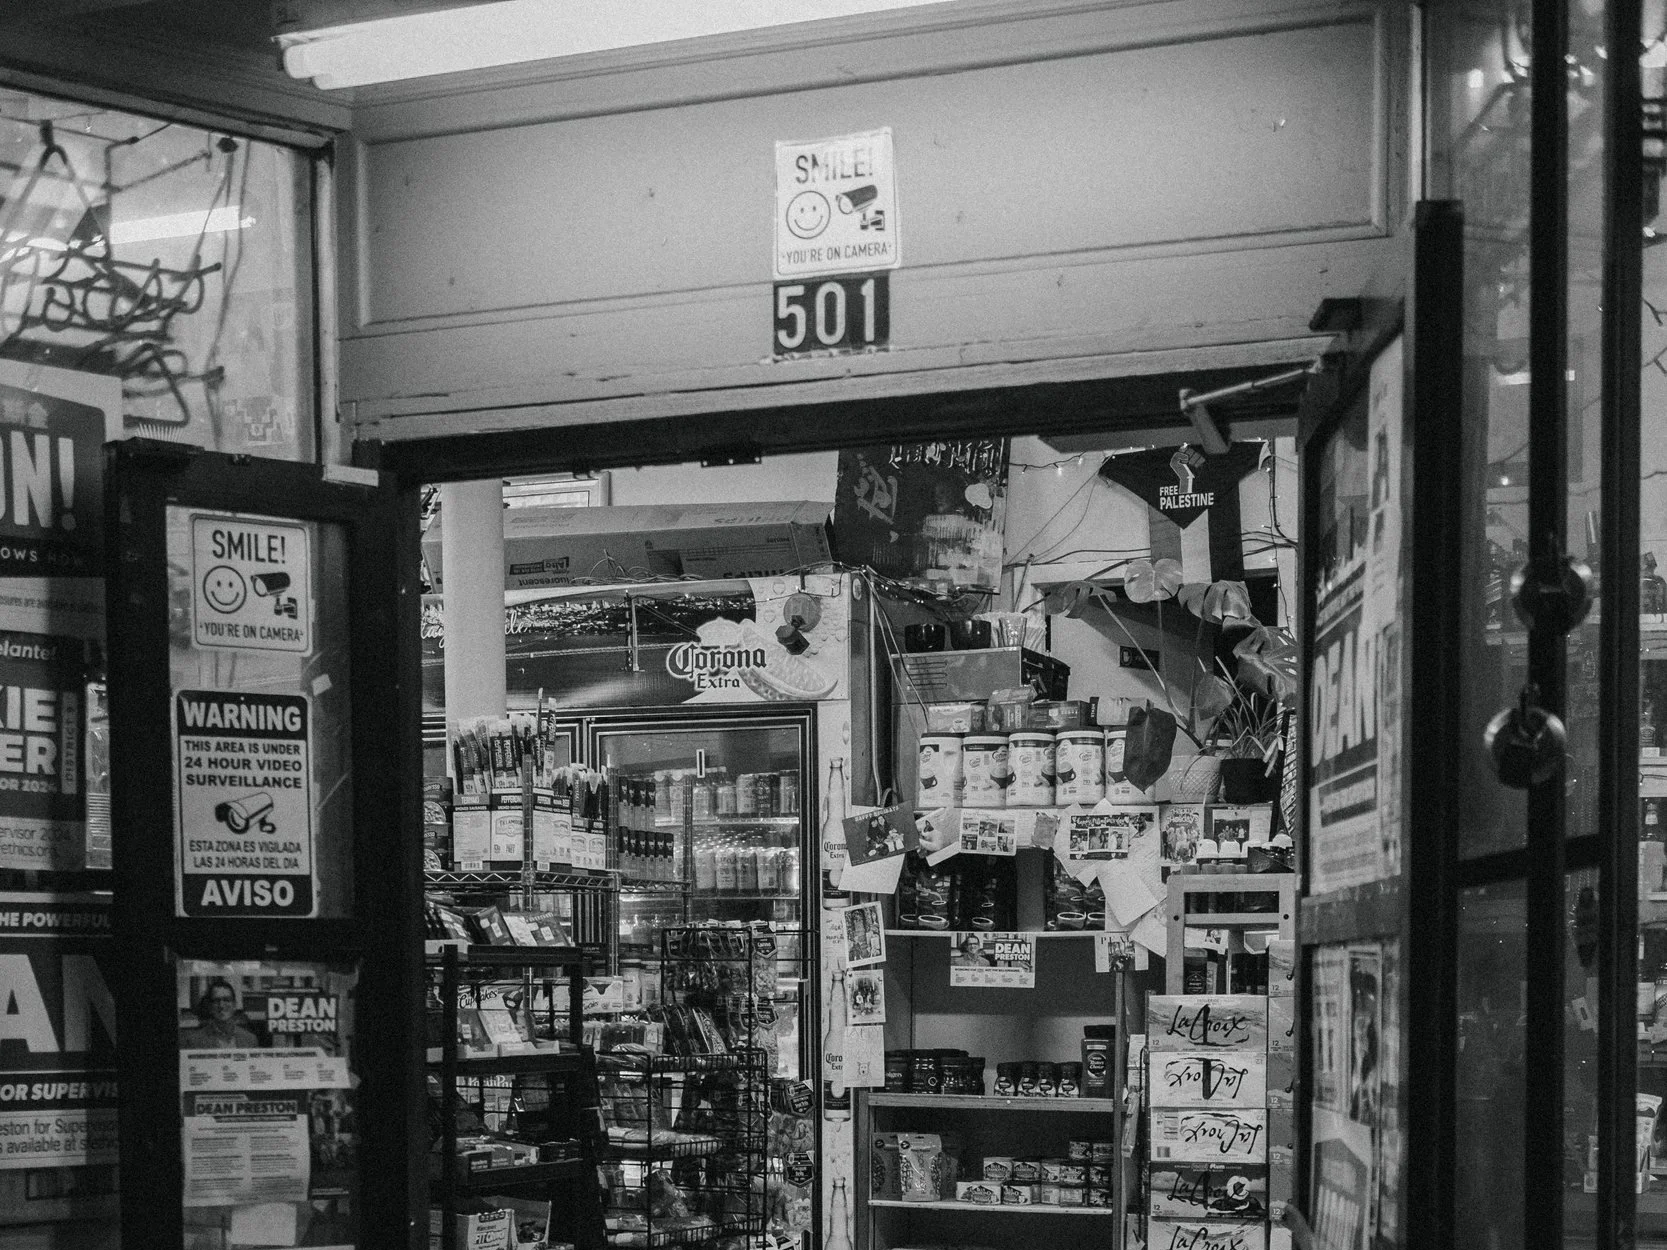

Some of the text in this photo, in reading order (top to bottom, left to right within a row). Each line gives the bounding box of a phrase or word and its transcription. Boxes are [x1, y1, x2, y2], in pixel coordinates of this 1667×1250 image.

[795, 148, 874, 184] SMILE!
[786, 241, 889, 264] YOU'RE ON CAMERA
[777, 279, 875, 349] 501
[0, 429, 77, 531] N!
[1159, 485, 1179, 498] FREE
[1159, 493, 1214, 510] PALESTINE
[212, 529, 286, 564] SMILE!
[204, 622, 301, 642] YOU'RE ON CAMERA
[667, 644, 767, 679] Corona
[696, 673, 741, 689] Extra
[1311, 630, 1376, 768] DEAN
[0, 685, 58, 733] IE
[182, 700, 302, 732] WARNING
[184, 740, 301, 756] THIS AREA IS UNDER
[184, 756, 302, 772] 24 HOUR VIDEO
[185, 774, 302, 789] SURVEILLANCE
[189, 840, 302, 854] ESTA ZONA ES VIGILADA
[193, 856, 299, 869] LAS 24 HORAS DEL DIA
[200, 879, 295, 907] AVISO
[995, 943, 1031, 954] DEAN
[995, 953, 1031, 962] PRESTON
[267, 997, 337, 1019] DEAN
[267, 1018, 337, 1033] PRESTON
[195, 1101, 296, 1115] DEAN PRESTON
[34, 1119, 51, 1135] for
